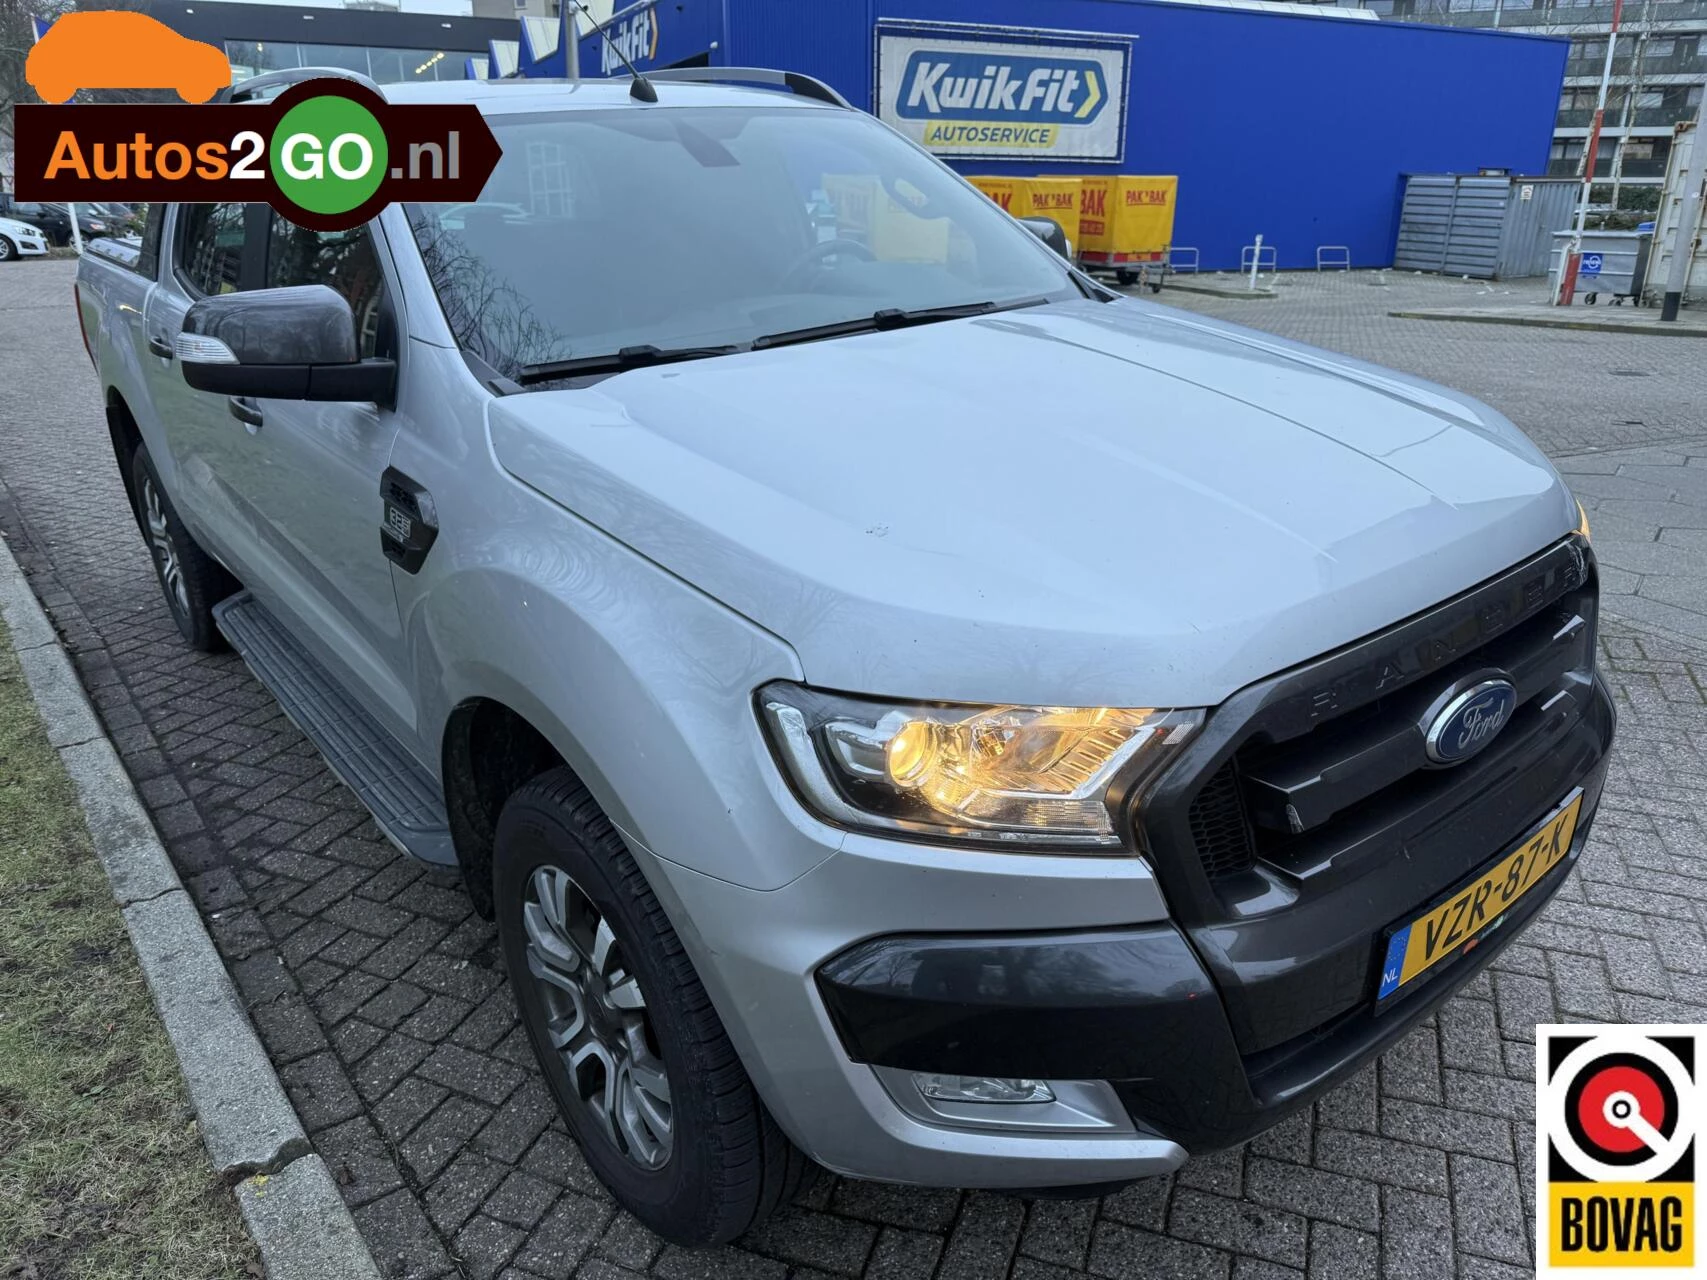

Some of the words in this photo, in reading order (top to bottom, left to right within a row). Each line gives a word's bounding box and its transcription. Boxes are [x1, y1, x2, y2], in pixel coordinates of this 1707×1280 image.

[931, 126, 1051, 143] AUTOSERVICE
[1458, 697, 1505, 750] Ford
[1424, 813, 1568, 960] VZR-87-K
[1381, 968, 1399, 987] NL
